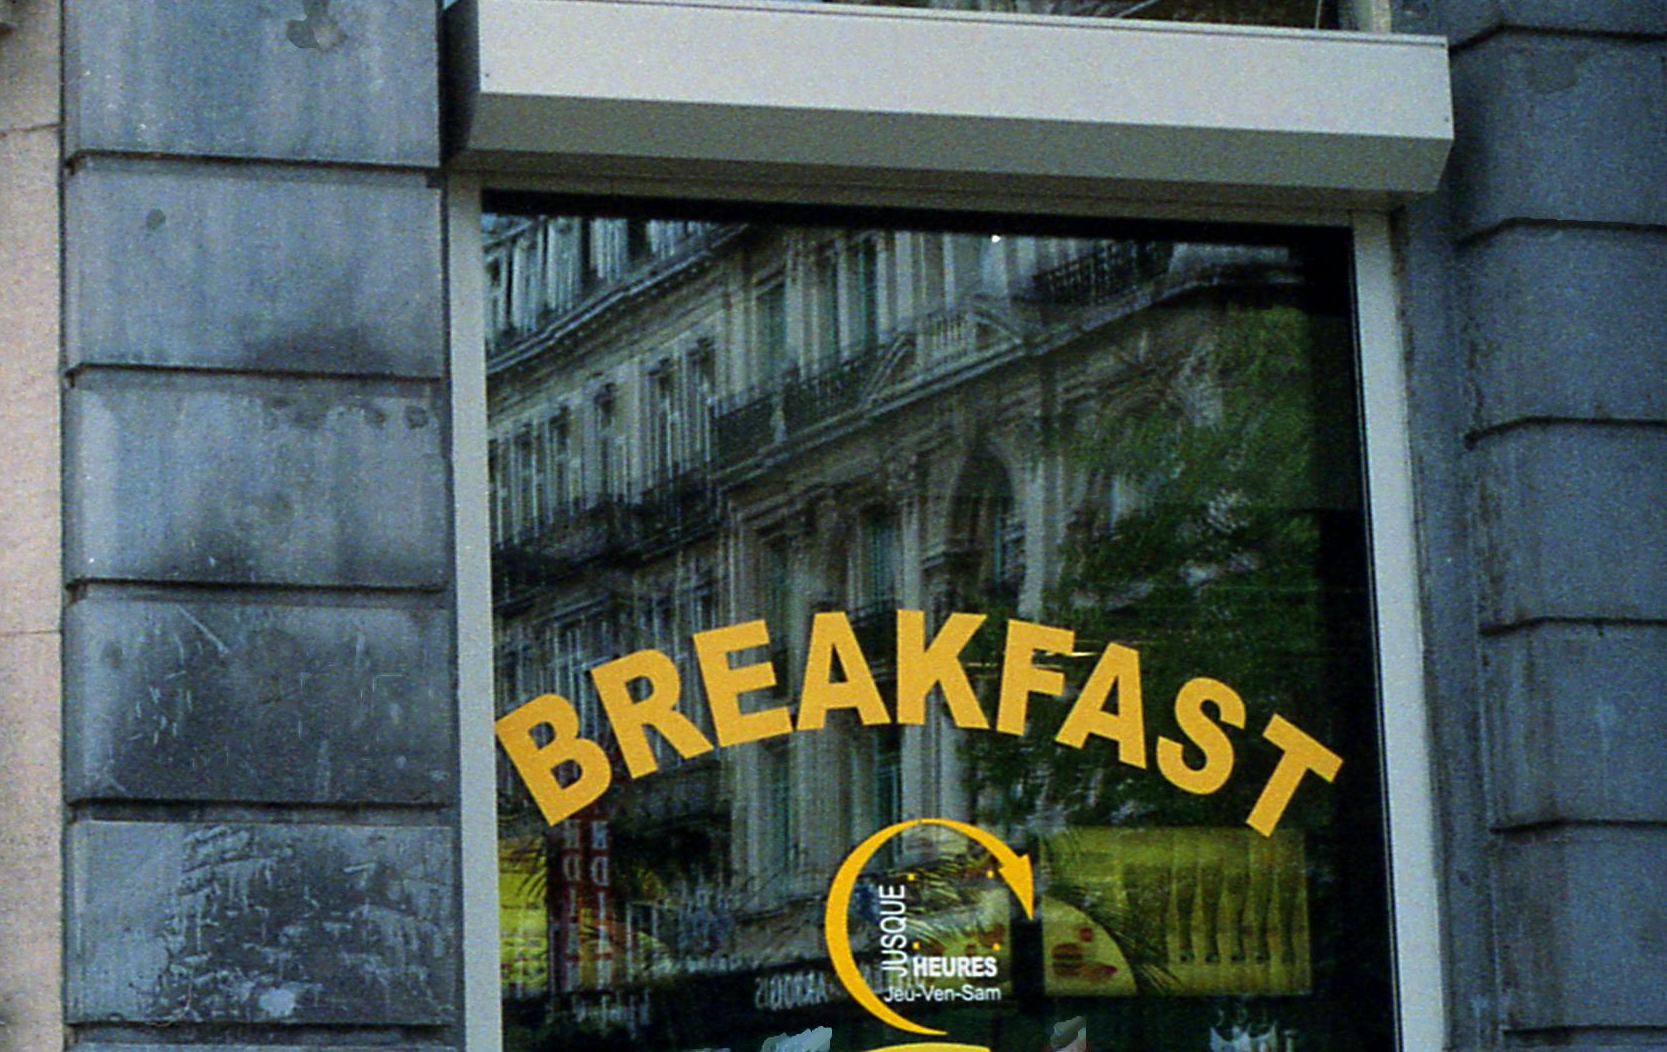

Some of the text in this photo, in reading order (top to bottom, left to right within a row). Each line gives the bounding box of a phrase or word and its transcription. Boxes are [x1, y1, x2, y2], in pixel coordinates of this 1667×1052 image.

[495, 608, 1344, 838] BREAKFAST
[879, 884, 907, 977] JUSQUE
[884, 984, 1001, 1003] Jeu-Ven-Sam
[912, 956, 998, 978] HEURES
